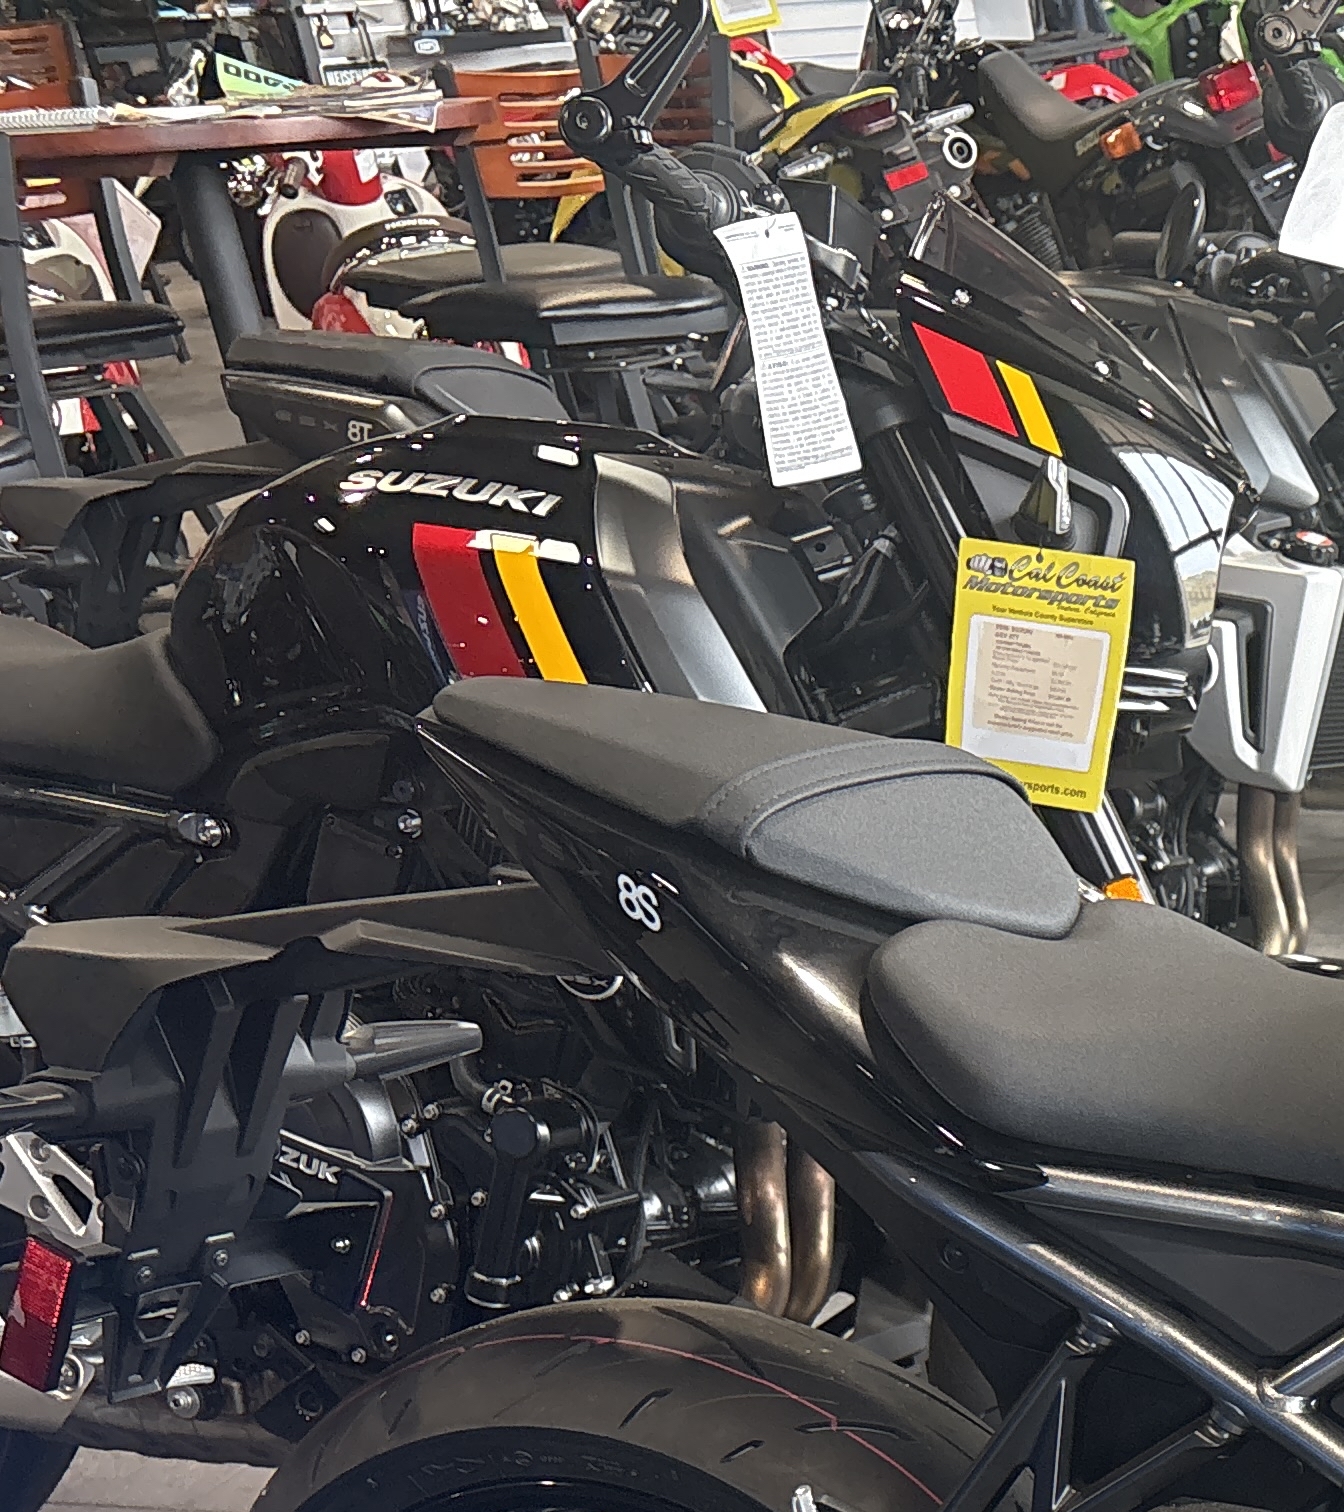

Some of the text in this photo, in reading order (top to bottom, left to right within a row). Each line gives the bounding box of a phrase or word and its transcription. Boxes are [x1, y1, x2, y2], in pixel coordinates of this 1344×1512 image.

[338, 469, 563, 518] SUZUKI
[962, 575, 1122, 611] Motorsports
[1007, 554, 1127, 593] Cal Coast
[1020, 781, 1087, 799] rsports.com
[617, 873, 662, 933] 8S
